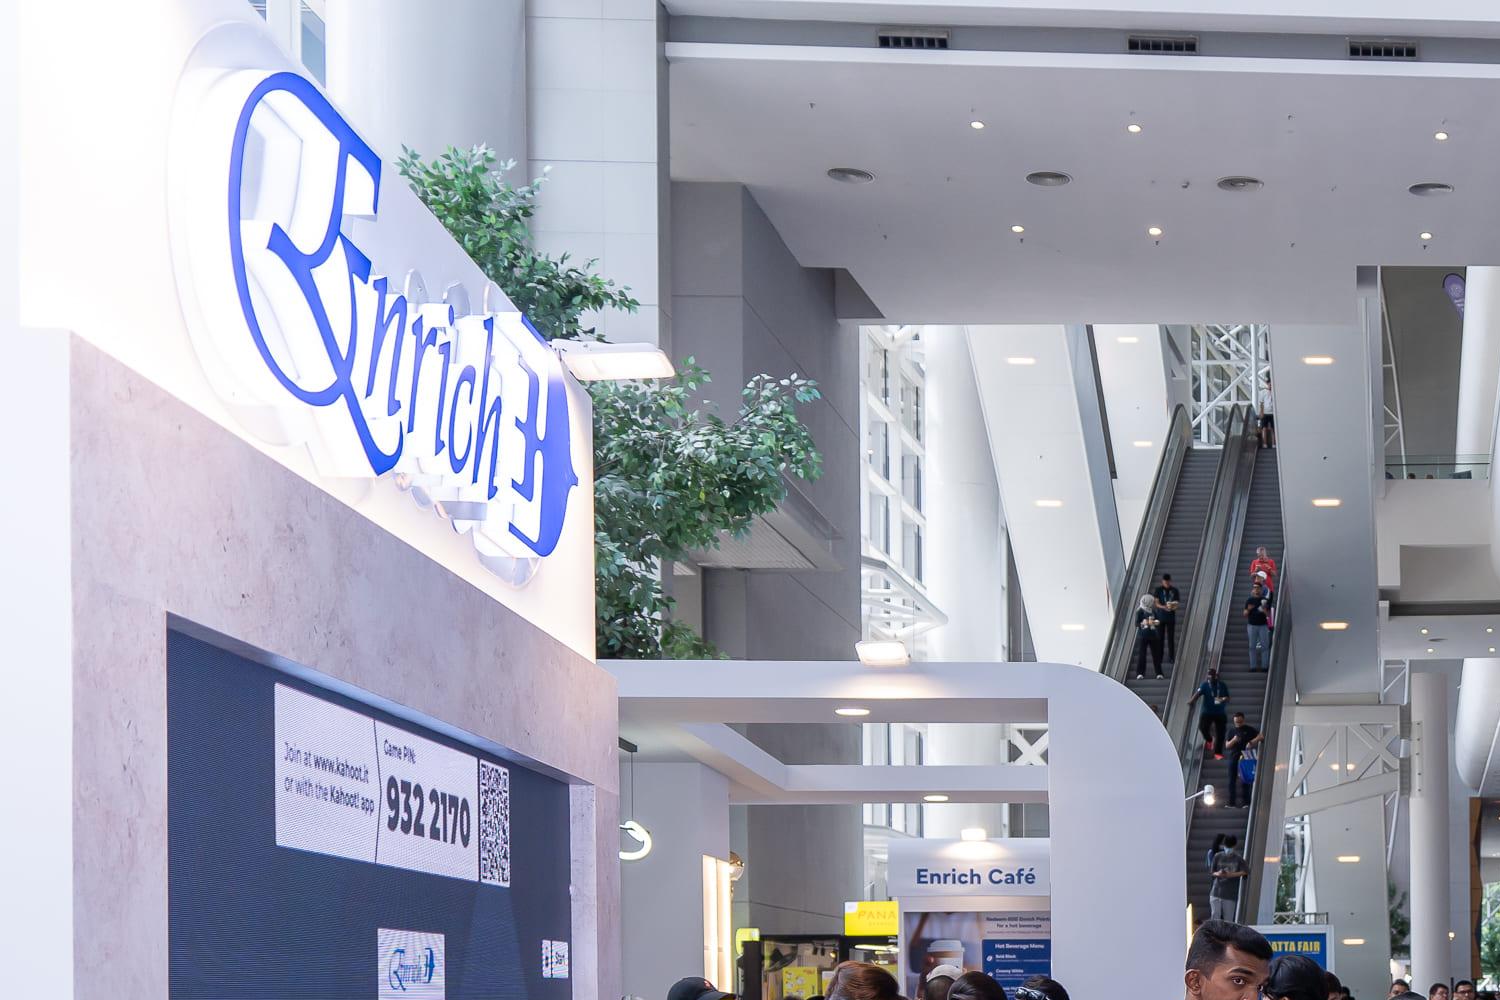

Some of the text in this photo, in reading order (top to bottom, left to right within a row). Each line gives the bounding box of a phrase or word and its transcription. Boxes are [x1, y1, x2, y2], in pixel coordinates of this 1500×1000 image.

[228, 71, 503, 500] Enrich
[284, 741, 302, 764] Join
[383, 739, 402, 761] Game
[361, 796, 376, 817] app
[386, 775, 472, 849] 932 2170
[916, 866, 1036, 885] Enrich Café
[1269, 940, 1321, 953] ATTA FAIR
